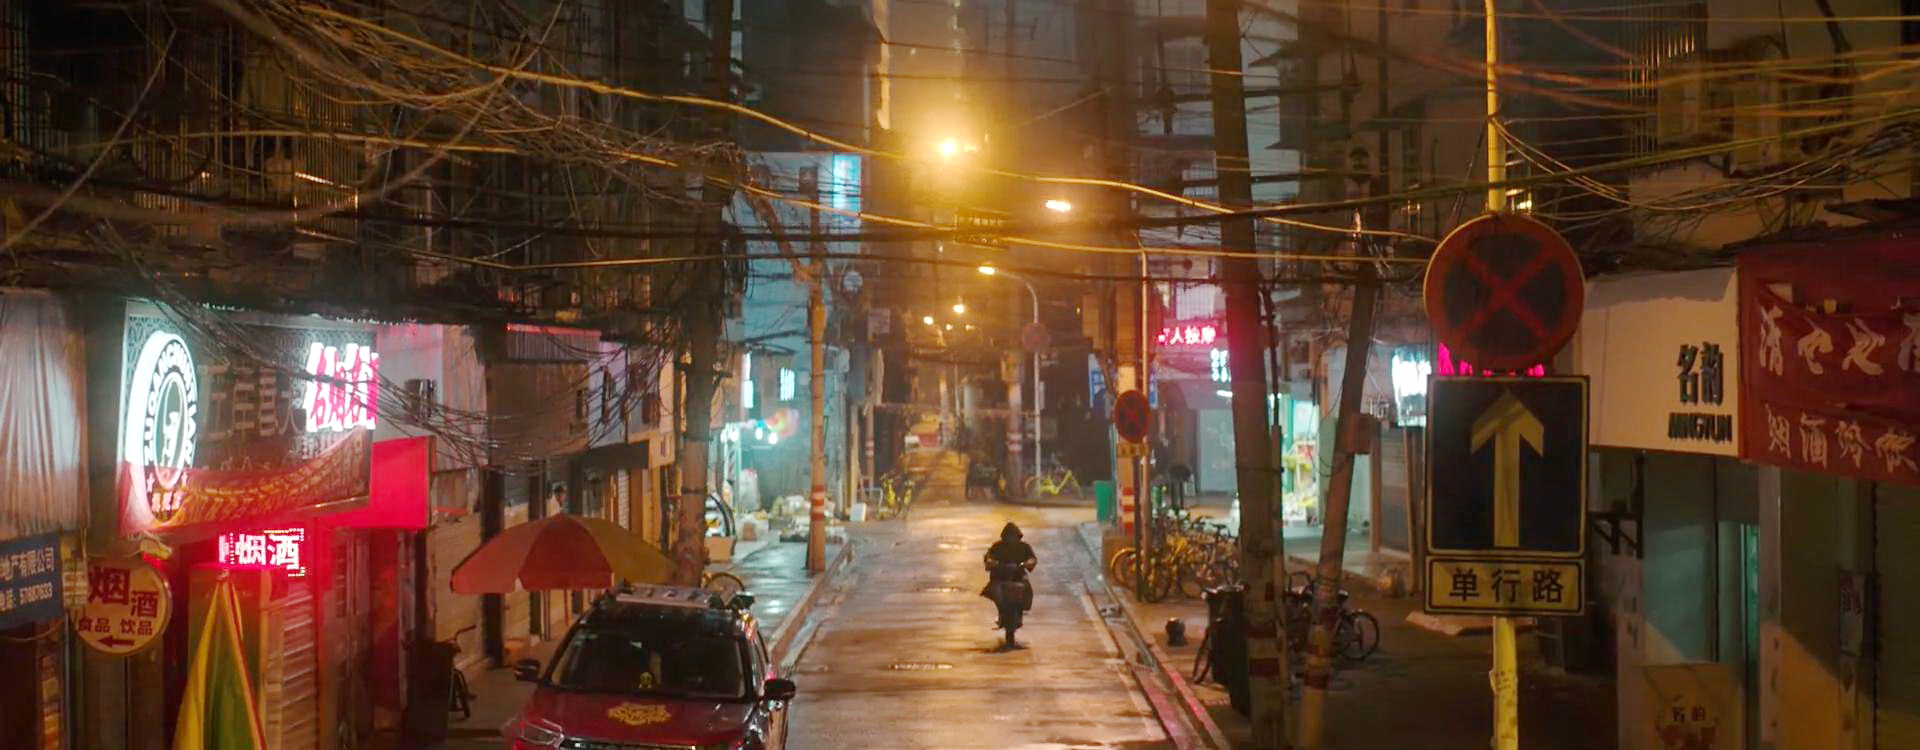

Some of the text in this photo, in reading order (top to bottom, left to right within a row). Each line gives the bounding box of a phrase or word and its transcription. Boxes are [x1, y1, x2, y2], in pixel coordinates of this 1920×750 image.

[235, 533, 300, 570] 烟酒
[89, 565, 160, 618] 烟酒
[1449, 567, 1564, 602] 单行路
[79, 615, 153, 636] 食品 饮品
